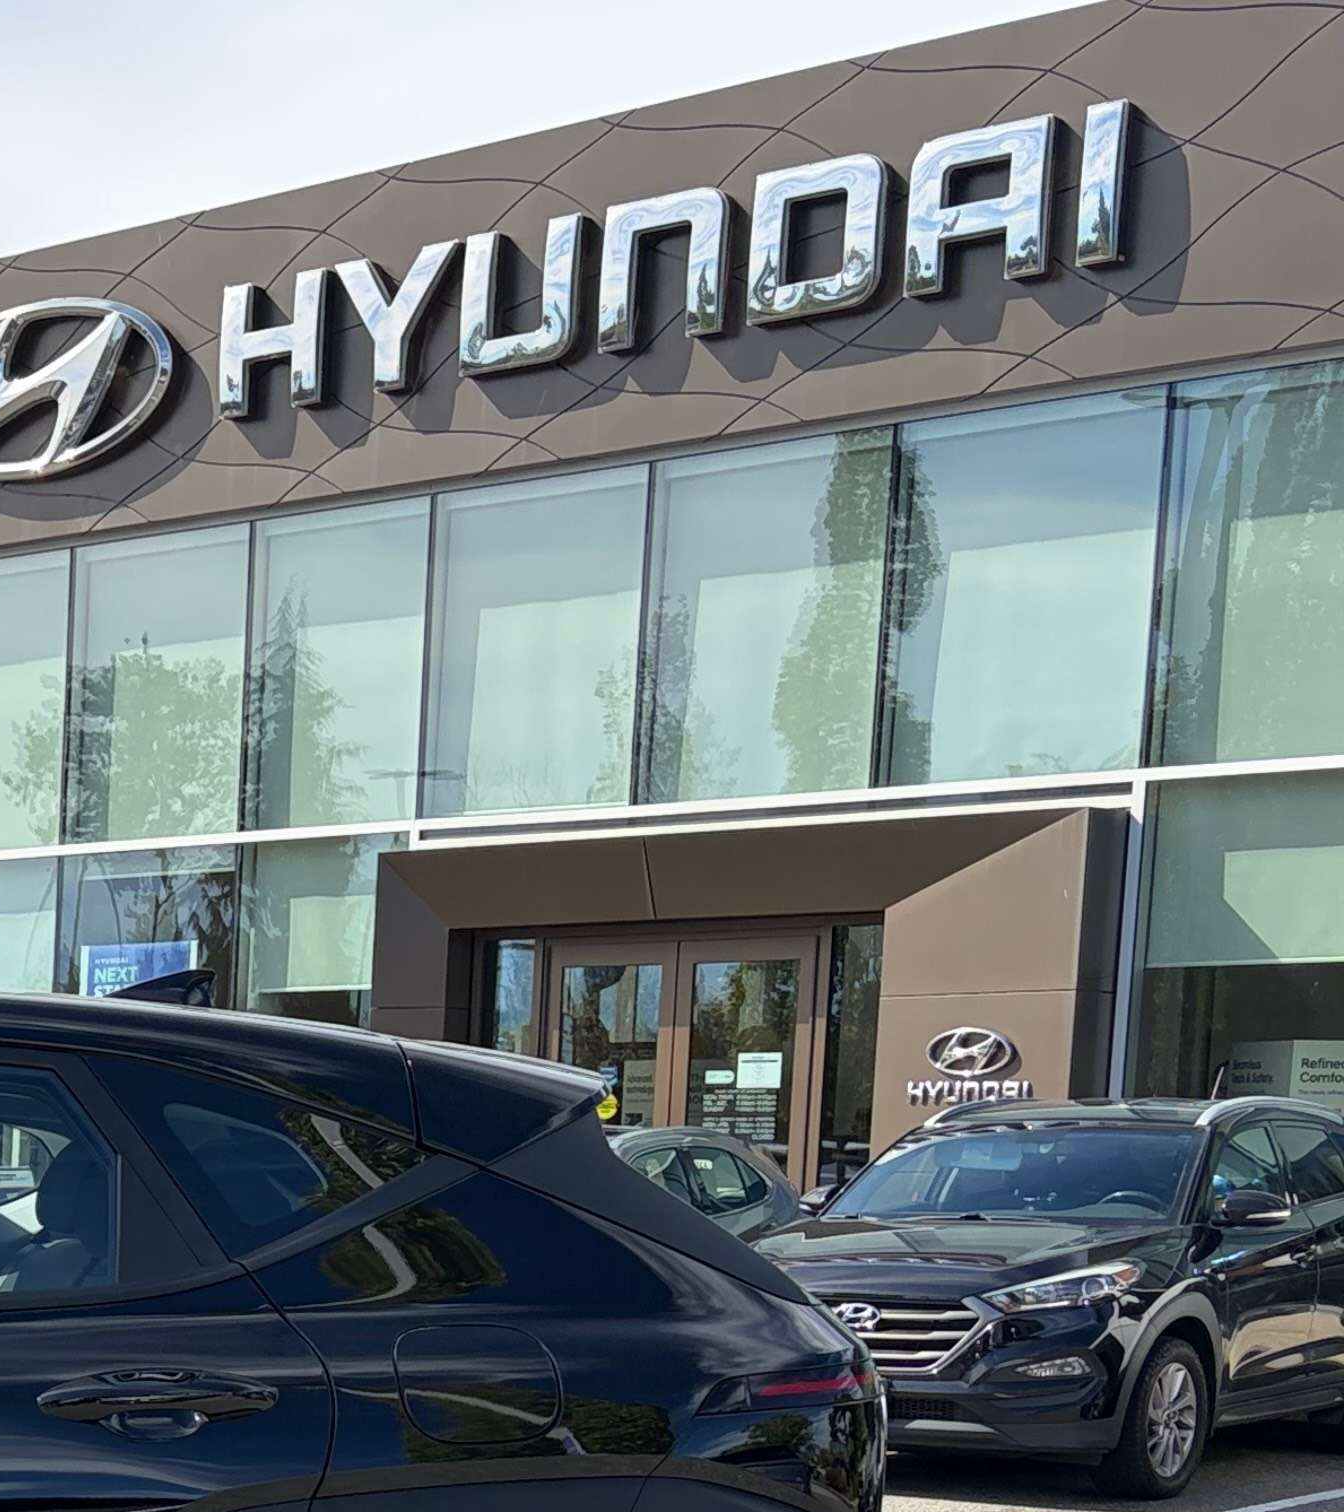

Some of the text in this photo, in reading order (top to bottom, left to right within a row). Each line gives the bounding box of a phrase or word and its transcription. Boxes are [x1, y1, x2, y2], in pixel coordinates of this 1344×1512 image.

[220, 97, 1132, 420] HYUNDAI
[94, 966, 138, 983] NEXT
[907, 1080, 1030, 1105] HYUNDAI
